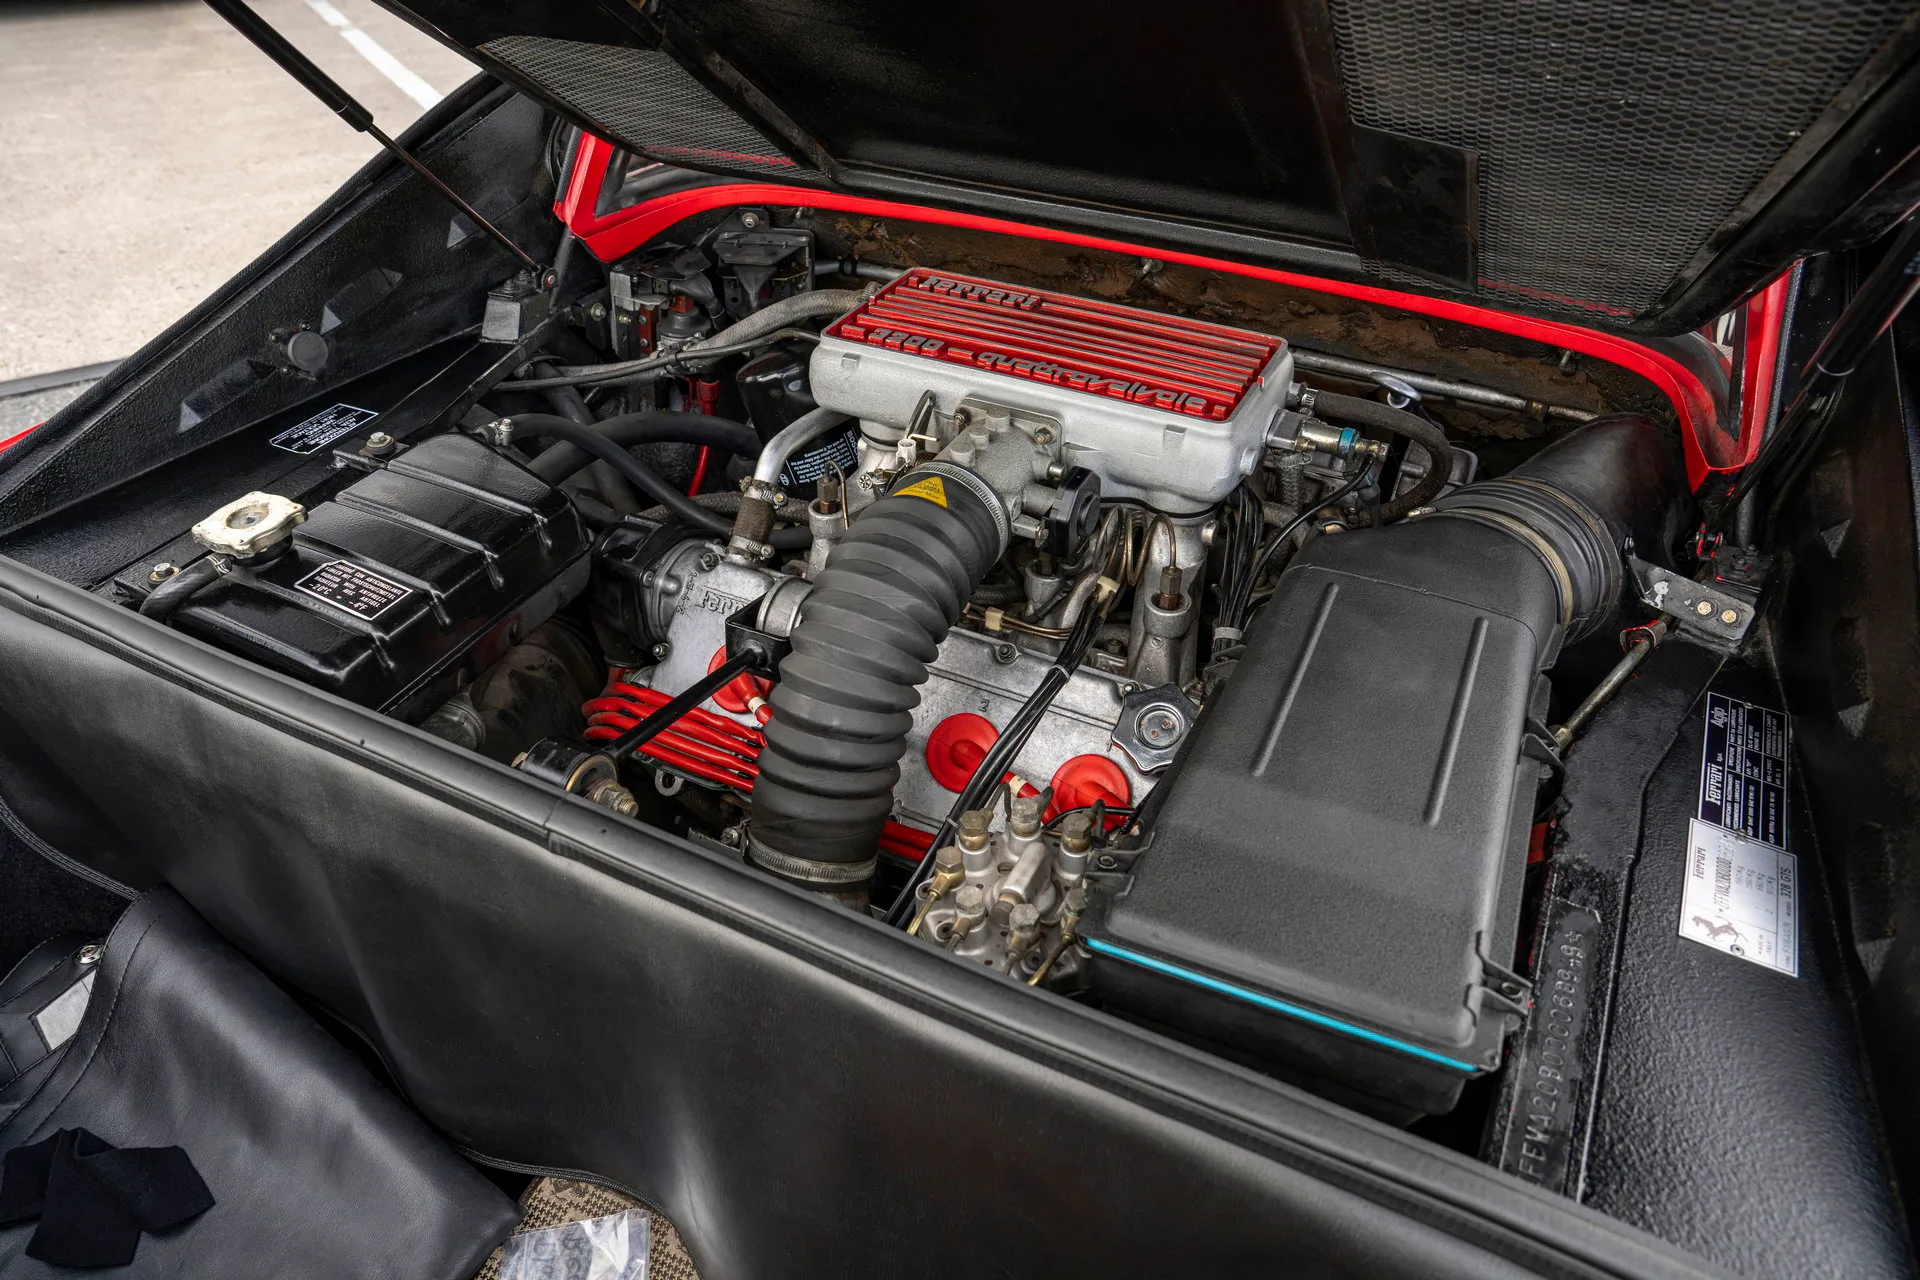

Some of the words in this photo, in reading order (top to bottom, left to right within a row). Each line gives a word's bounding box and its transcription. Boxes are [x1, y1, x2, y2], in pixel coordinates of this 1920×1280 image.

[919, 276, 1041, 311] Ferrari
[868, 327, 944, 356] 3200
[978, 350, 1209, 415] quattrovalvole
[978, 698, 990, 712] 2
[1711, 707, 1727, 727] Agip
[1706, 764, 1722, 804] Ferrari
[1693, 847, 1705, 879] Ferrari
[1780, 867, 1791, 882] GTS
[1780, 883, 1791, 898] 328
